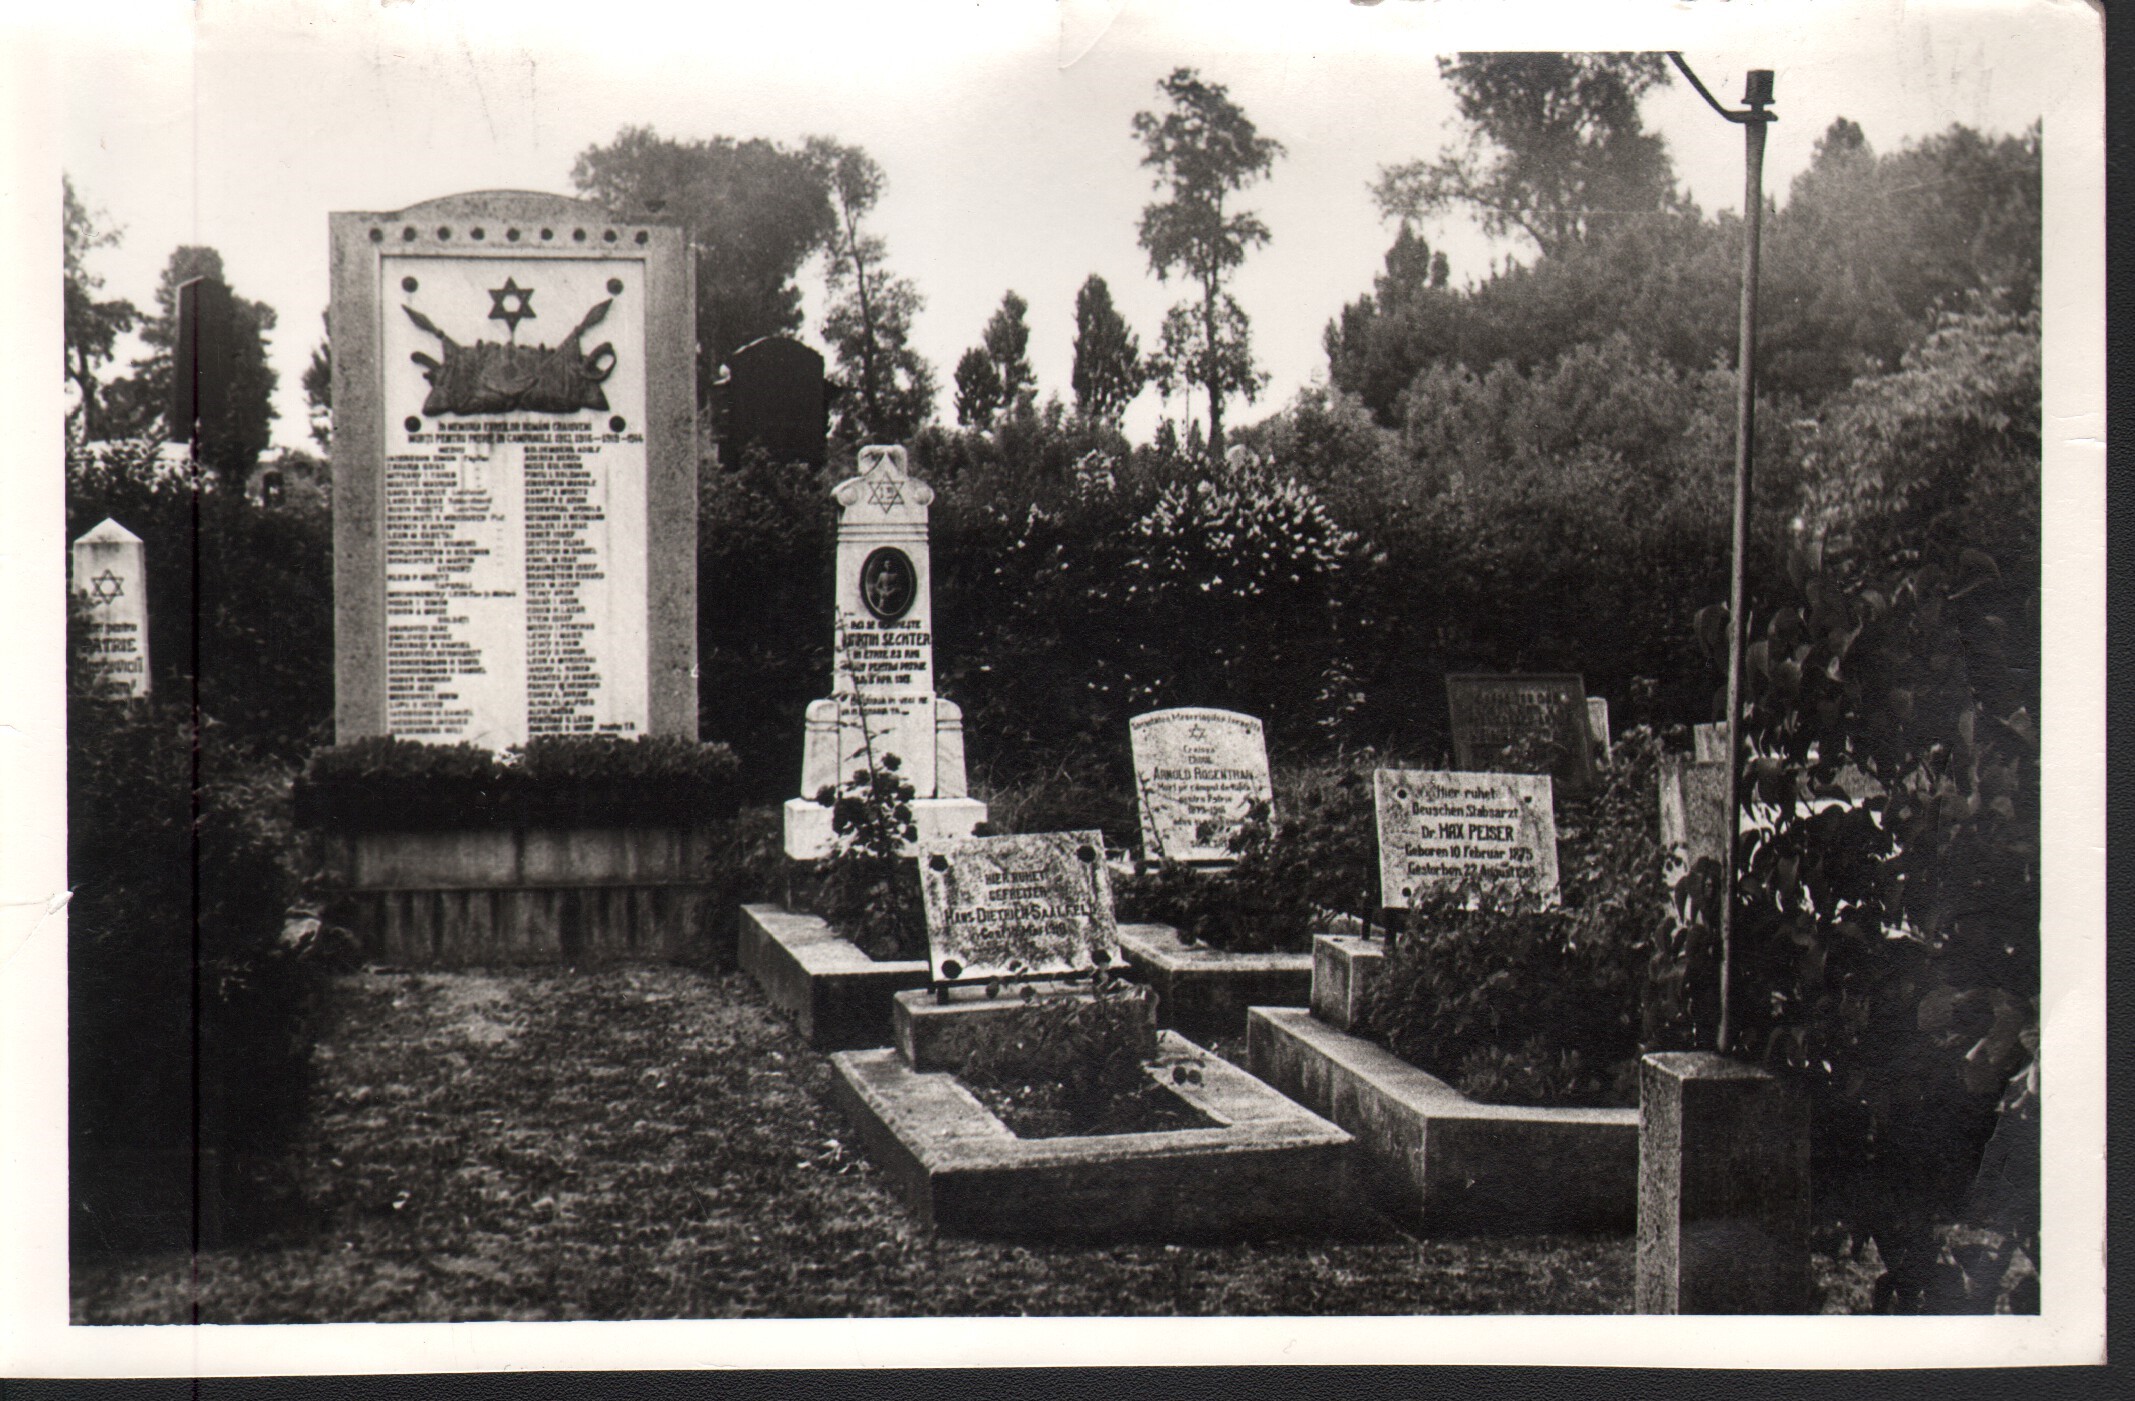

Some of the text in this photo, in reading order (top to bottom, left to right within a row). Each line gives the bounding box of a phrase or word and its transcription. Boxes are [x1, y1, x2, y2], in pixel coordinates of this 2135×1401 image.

[881, 632, 932, 647] SECHTER
[1183, 744, 1216, 754] Craiova
[1194, 766, 1253, 781] ROSENTHAL
[1434, 784, 1460, 799] Hier
[1438, 822, 1464, 840] MAX
[1468, 824, 1514, 842] PEISER
[1404, 843, 1449, 858] Geboren
[1450, 845, 1461, 859] 10
[1463, 845, 1507, 860] Februar
[988, 886, 1047, 901] GEFREITER
